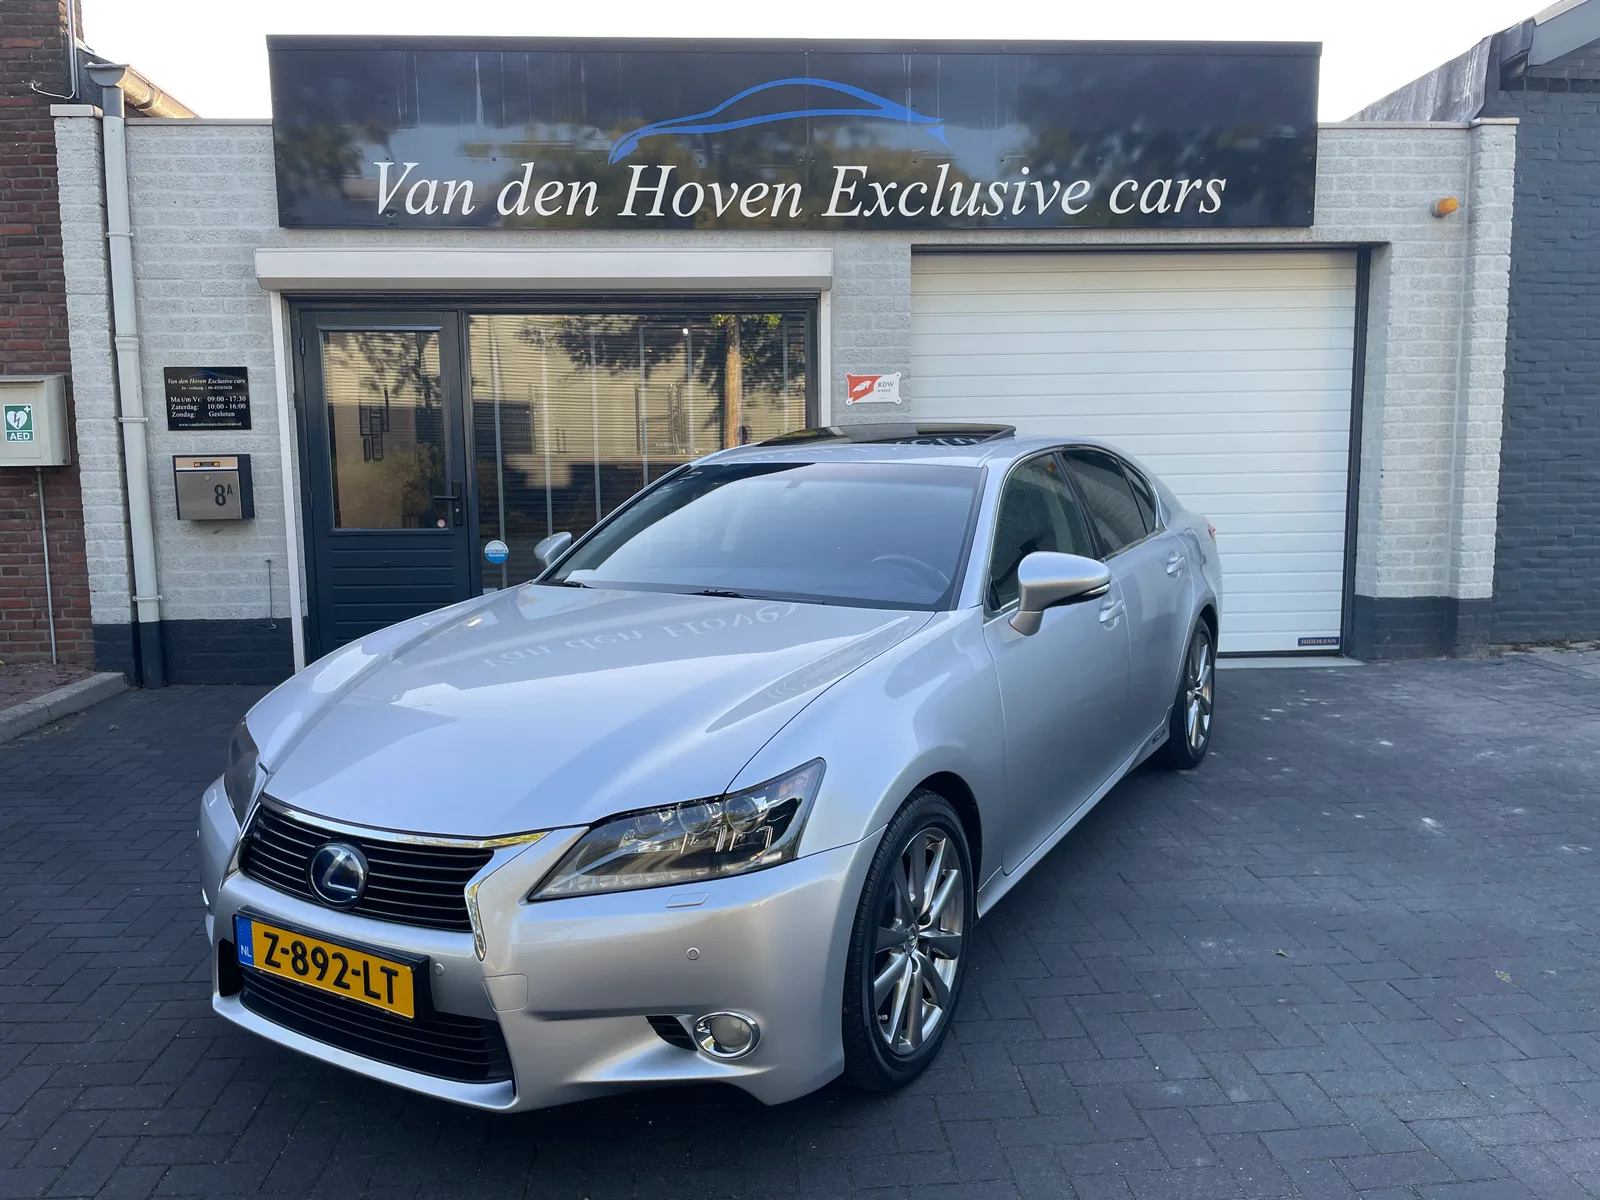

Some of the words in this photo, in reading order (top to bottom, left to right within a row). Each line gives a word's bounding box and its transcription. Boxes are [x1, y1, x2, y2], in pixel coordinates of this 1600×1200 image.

[373, 161, 476, 216] Van
[497, 162, 600, 217] den
[617, 165, 803, 218] Hoven
[821, 163, 1091, 217] Exclusive
[1109, 177, 1227, 215] cars
[172, 411, 197, 419] Zondag:
[10, 432, 30, 441] AED
[240, 944, 253, 958] NL
[263, 931, 399, 1005] Z-892-LT
